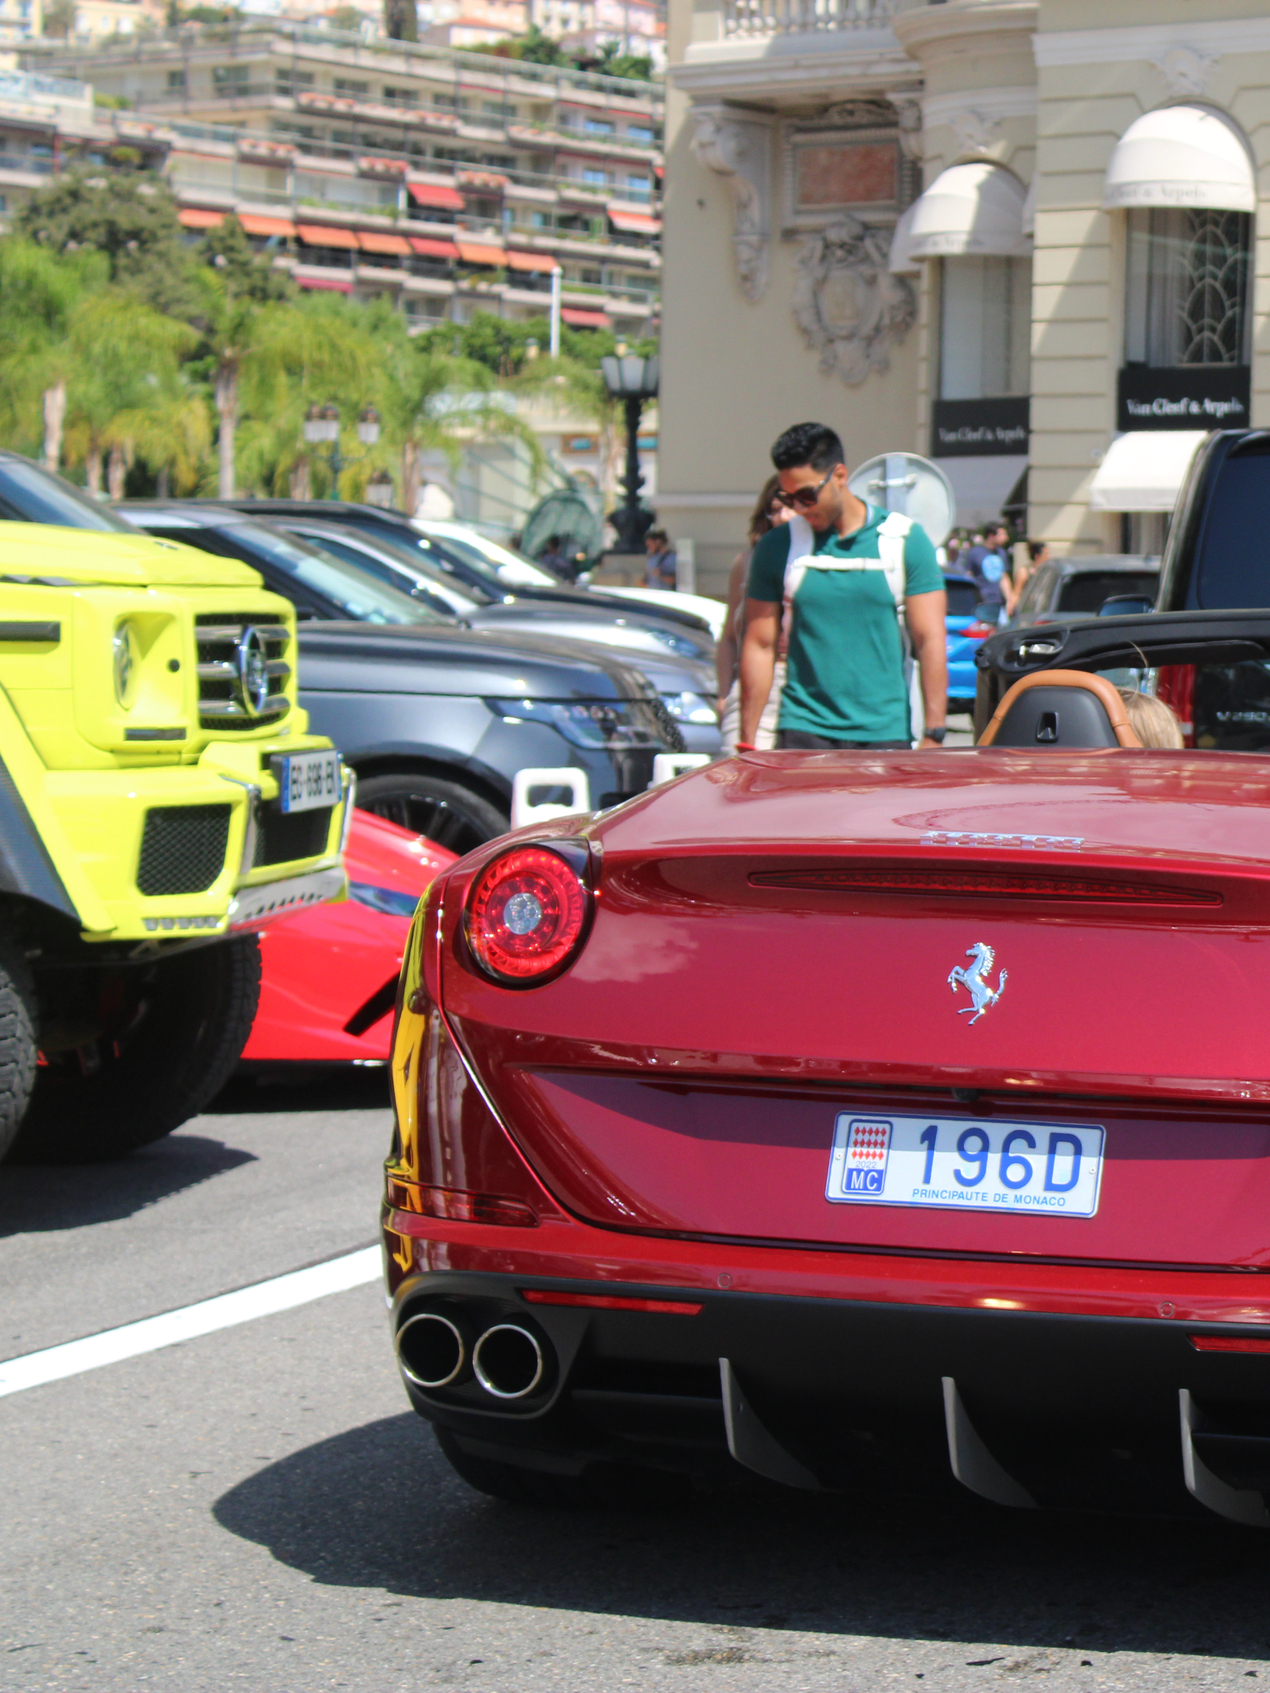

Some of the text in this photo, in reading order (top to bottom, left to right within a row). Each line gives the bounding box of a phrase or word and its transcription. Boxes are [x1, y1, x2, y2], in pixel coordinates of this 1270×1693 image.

[1203, 397, 1244, 419] Arpels
[855, 1160, 877, 1169] 2022
[919, 1124, 1083, 1193] 196D
[850, 1170, 879, 1190] MC
[912, 1188, 1066, 1207] PRINCIPAUTE DE MONACO
